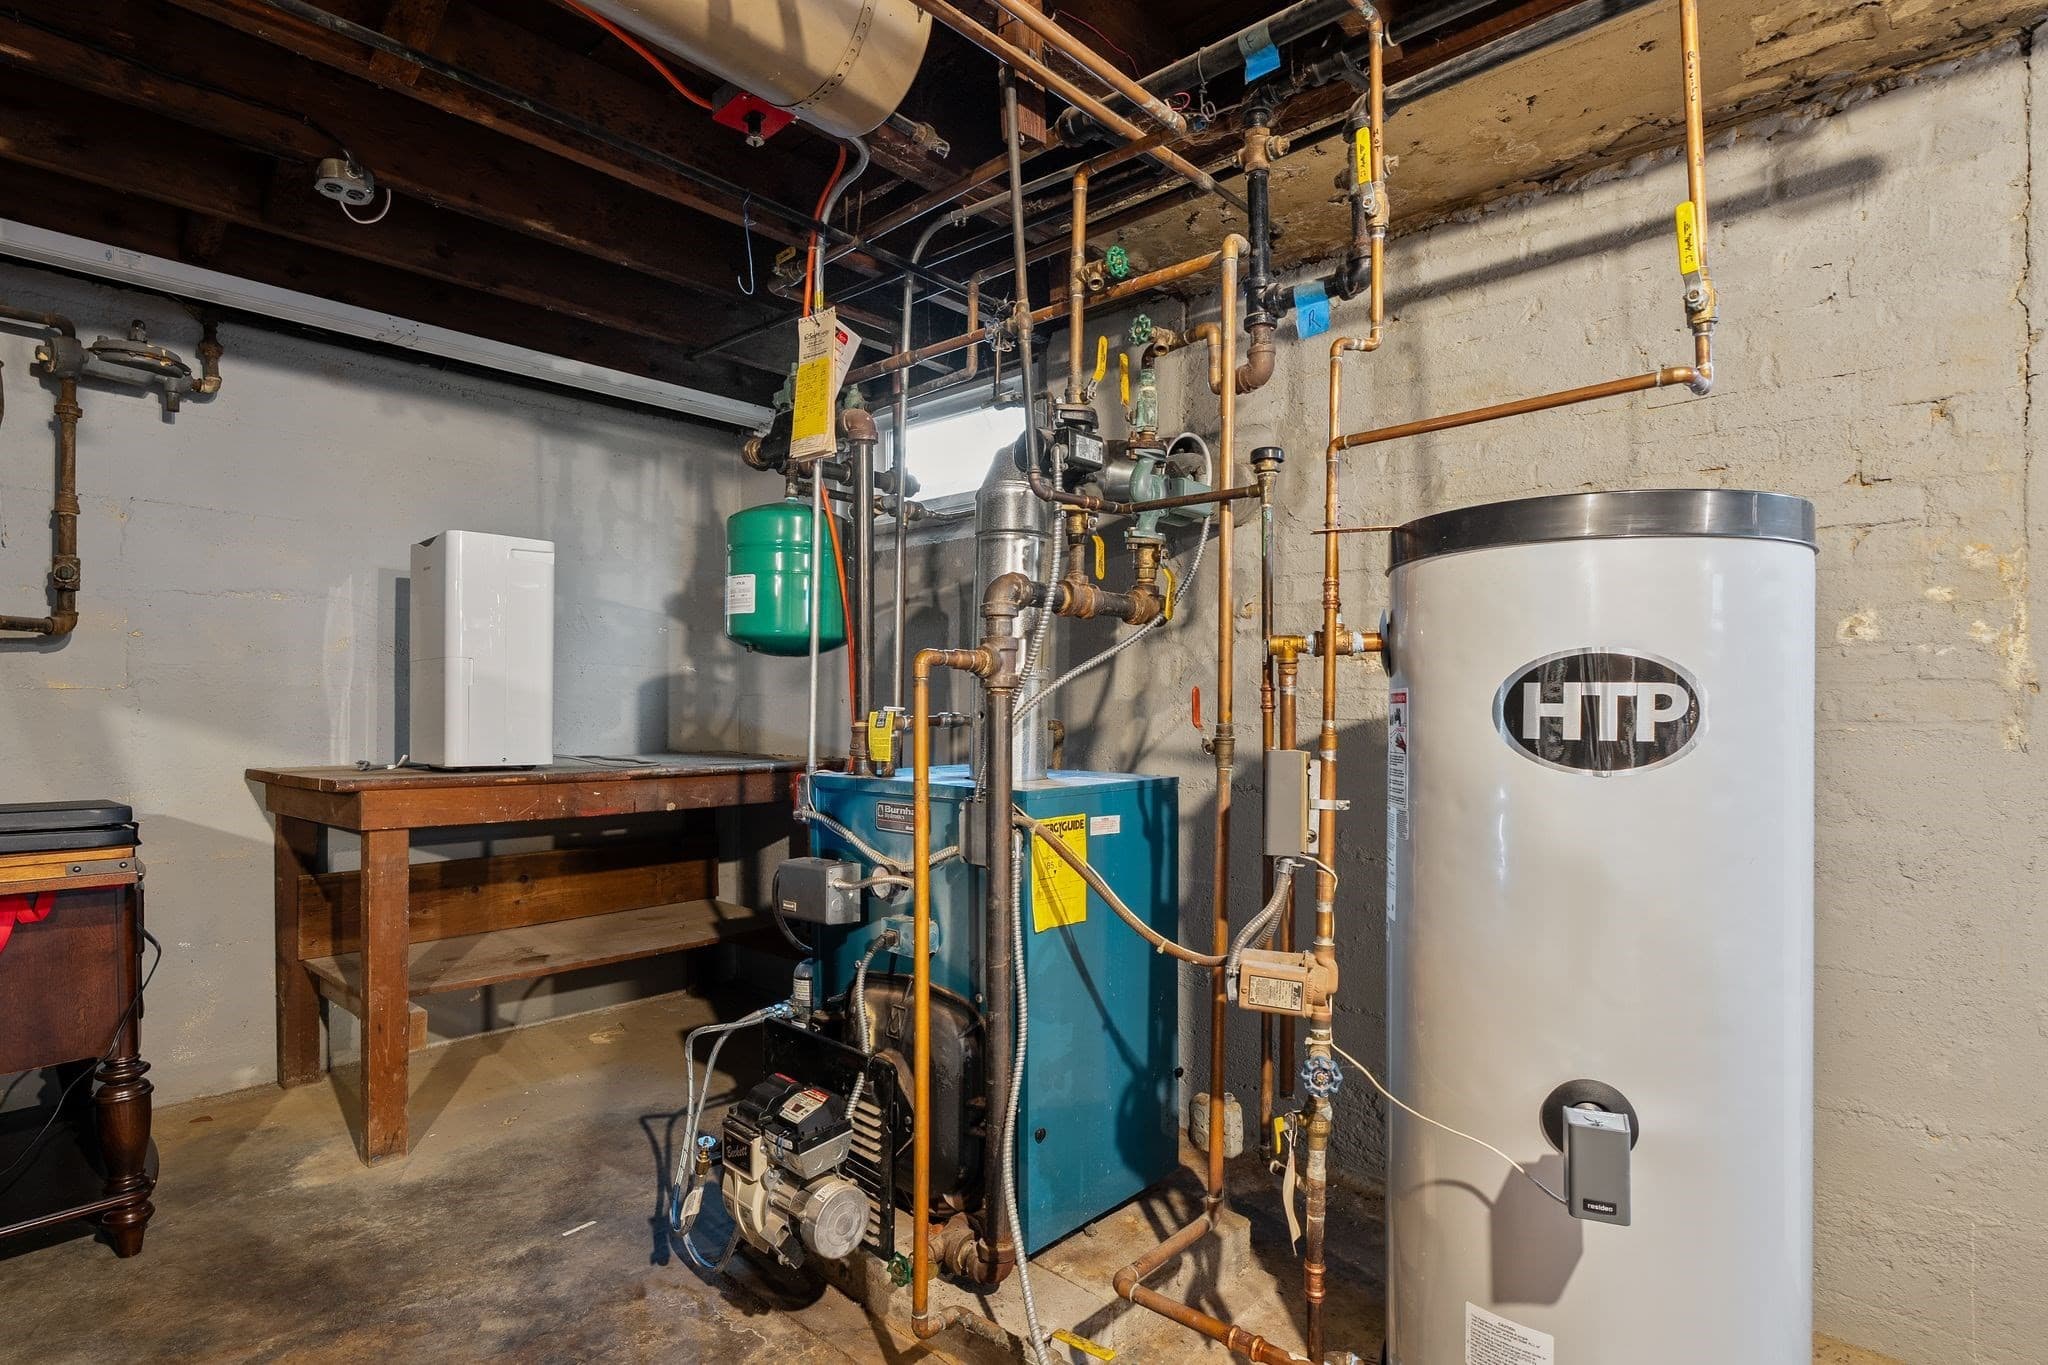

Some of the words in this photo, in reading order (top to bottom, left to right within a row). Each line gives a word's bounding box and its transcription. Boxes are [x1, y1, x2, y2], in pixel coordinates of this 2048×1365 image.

[1308, 309, 1322, 328] R
[1522, 681, 1691, 742] HTP
[884, 805, 914, 816] Burnh
[1587, 1203, 1614, 1213] resideo
